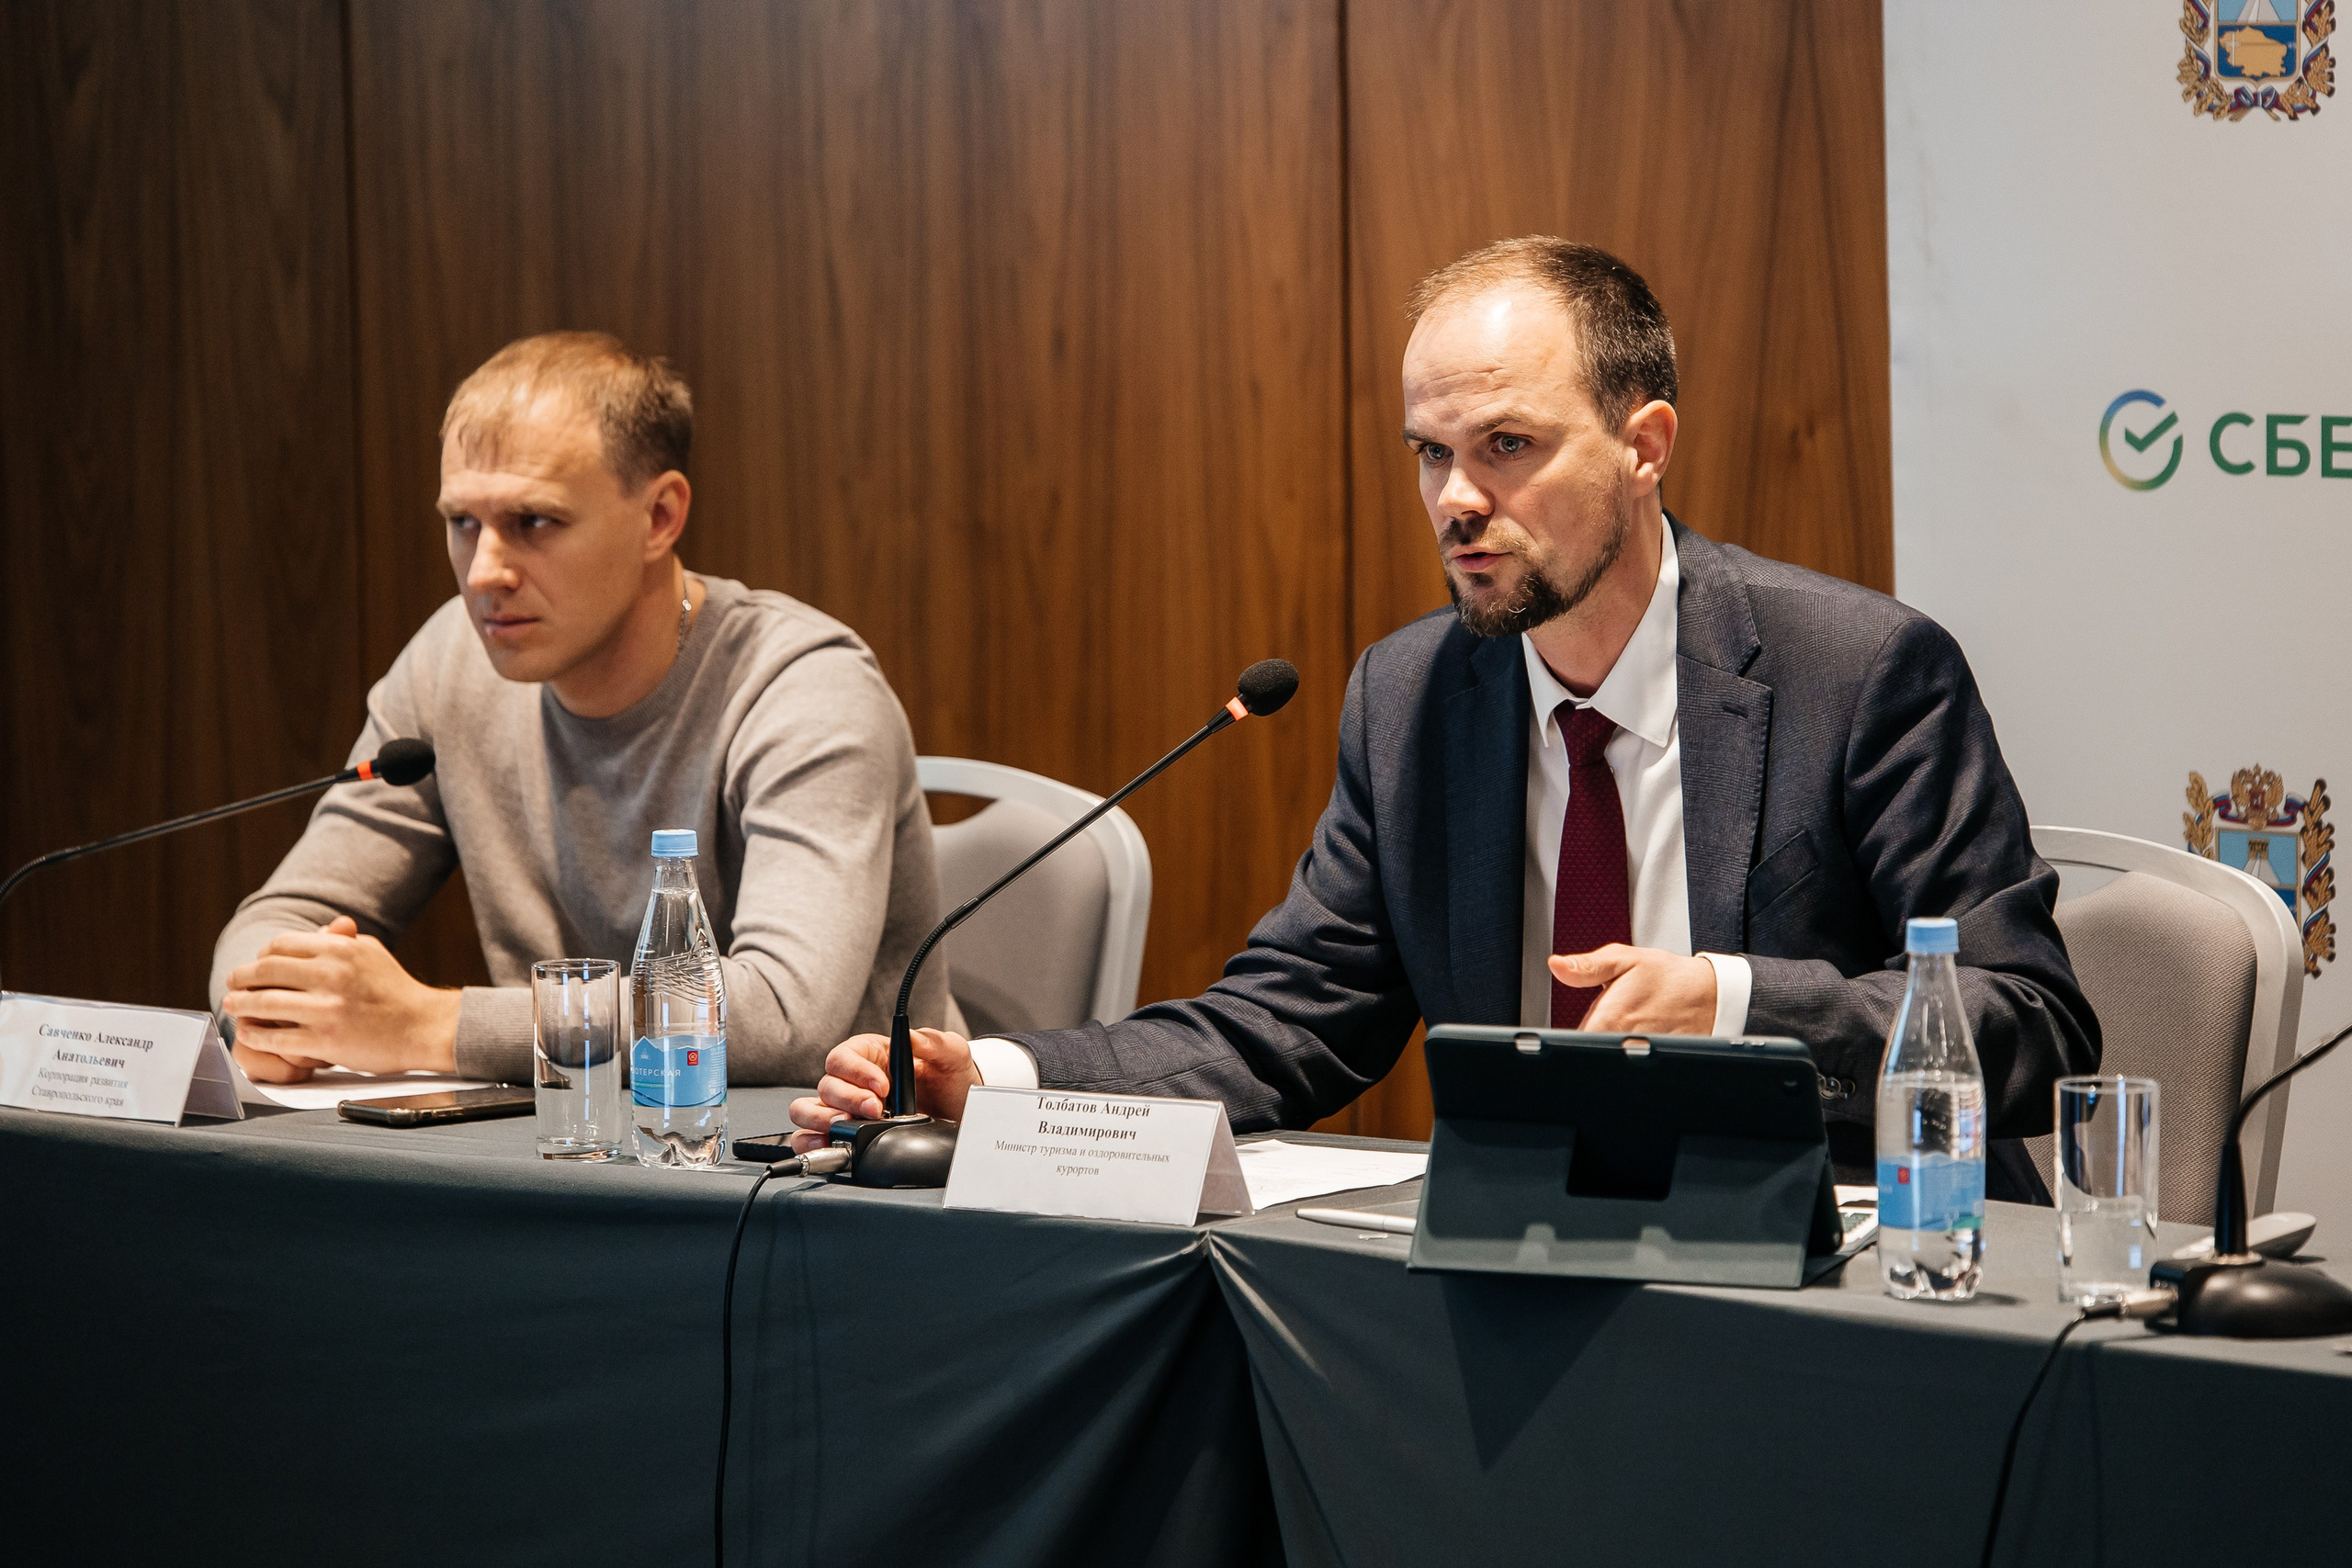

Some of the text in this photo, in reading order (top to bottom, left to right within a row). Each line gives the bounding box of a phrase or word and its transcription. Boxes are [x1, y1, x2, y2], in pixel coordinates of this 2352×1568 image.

[39, 1023, 153, 1051] Савченко Александр
[52, 1048, 125, 1068] Анатольевич
[38, 1067, 129, 1089] Корпорация развития
[31, 1085, 124, 1108] Ставропольского края
[1036, 1096, 1150, 1119] Толбатов Андрей
[1037, 1121, 1137, 1141] Владимирович
[994, 1140, 1170, 1164] Министр туризма и оздоровительных
[1056, 1163, 1100, 1178] курортов
